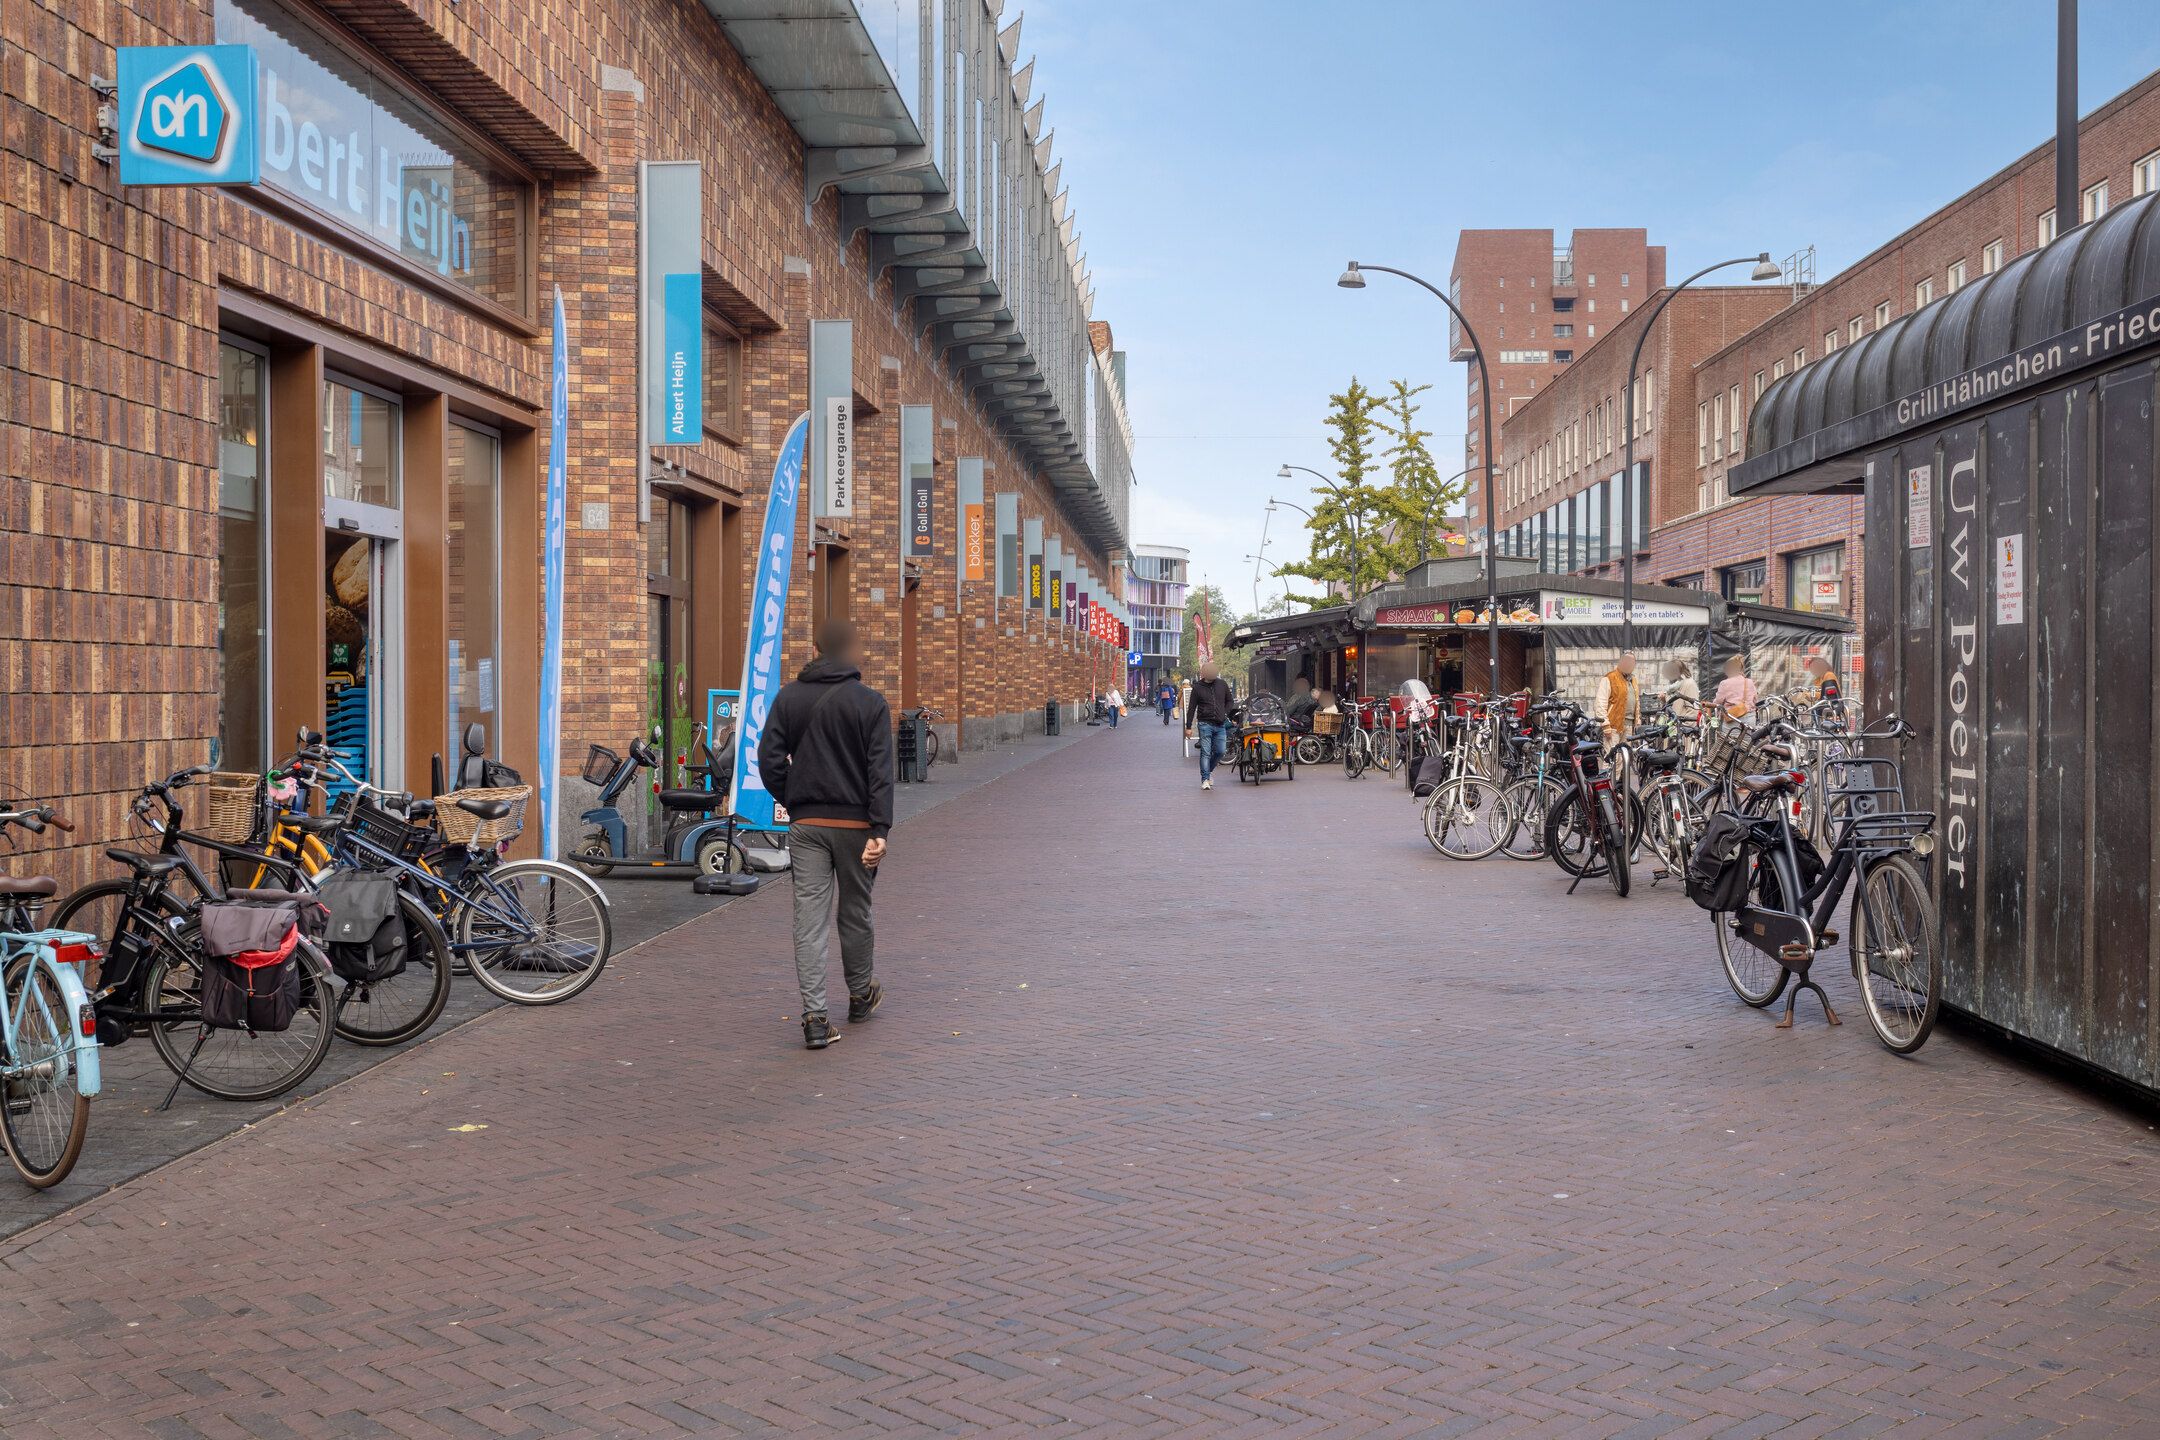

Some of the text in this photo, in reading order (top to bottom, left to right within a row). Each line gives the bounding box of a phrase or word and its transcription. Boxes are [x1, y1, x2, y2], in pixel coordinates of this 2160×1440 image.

[264, 67, 471, 276] bert Heijn
[672, 351, 687, 435] Albert Heijn
[1897, 386, 1938, 425] Grill
[1942, 345, 2062, 409] Hähnchen
[834, 404, 848, 509] Parkeergarage
[588, 509, 604, 525] 64
[1031, 564, 1041, 599] xenos
[1051, 578, 1060, 609] xenos
[1565, 598, 1593, 608] BEST
[1567, 607, 1592, 615] MOBILE
[1658, 609, 1684, 618] tablet's
[1947, 449, 1977, 889] Uw Poelier
